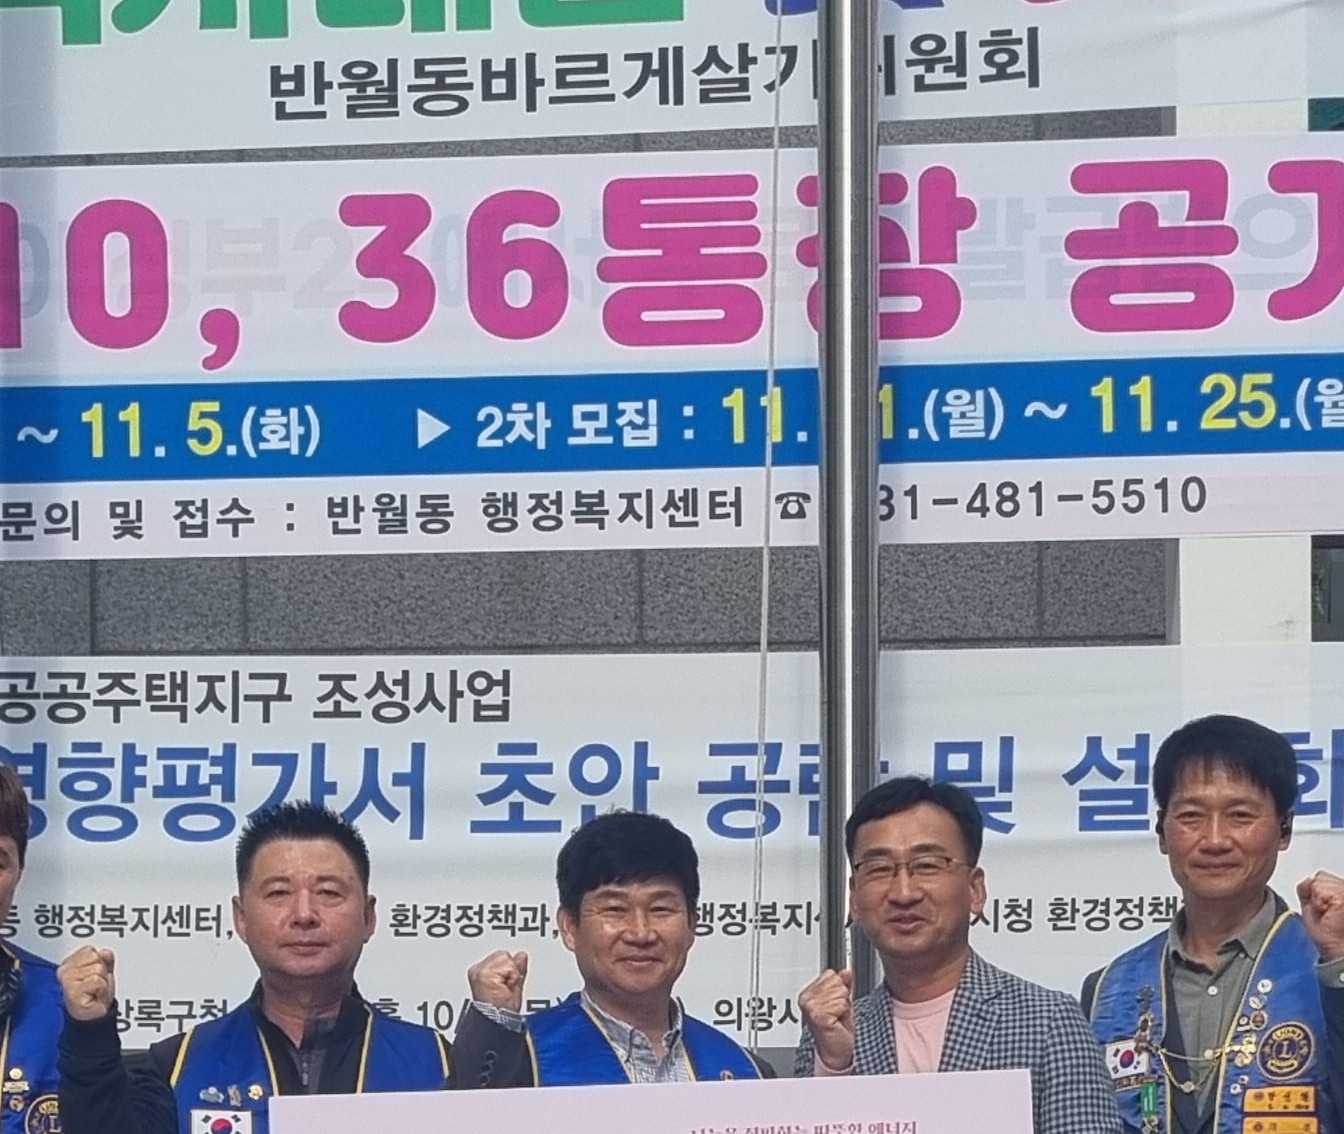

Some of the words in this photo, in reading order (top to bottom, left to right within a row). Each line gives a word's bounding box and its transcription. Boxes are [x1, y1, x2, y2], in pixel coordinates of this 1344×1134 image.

[82, 408, 166, 459] 11.
[187, 402, 320, 459] 5.(화)
[476, 402, 551, 450] 2차
[568, 399, 659, 448] 모집
[722, 387, 809, 444] 11.
[1091, 377, 1178, 433] 11.
[0, 500, 82, 542] 문의
[109, 499, 146, 540] 및
[172, 497, 256, 539] 접수
[326, 493, 455, 537] 반월동
[481, 484, 743, 534] 행정복지센터
[878, 476, 1208, 524] 31-481-5510
[312, 668, 513, 724] 조성사업
[469, 741, 660, 836] 초안
[34, 903, 234, 939] 행정복지센터,
[389, 902, 561, 940] 환경정책과,
